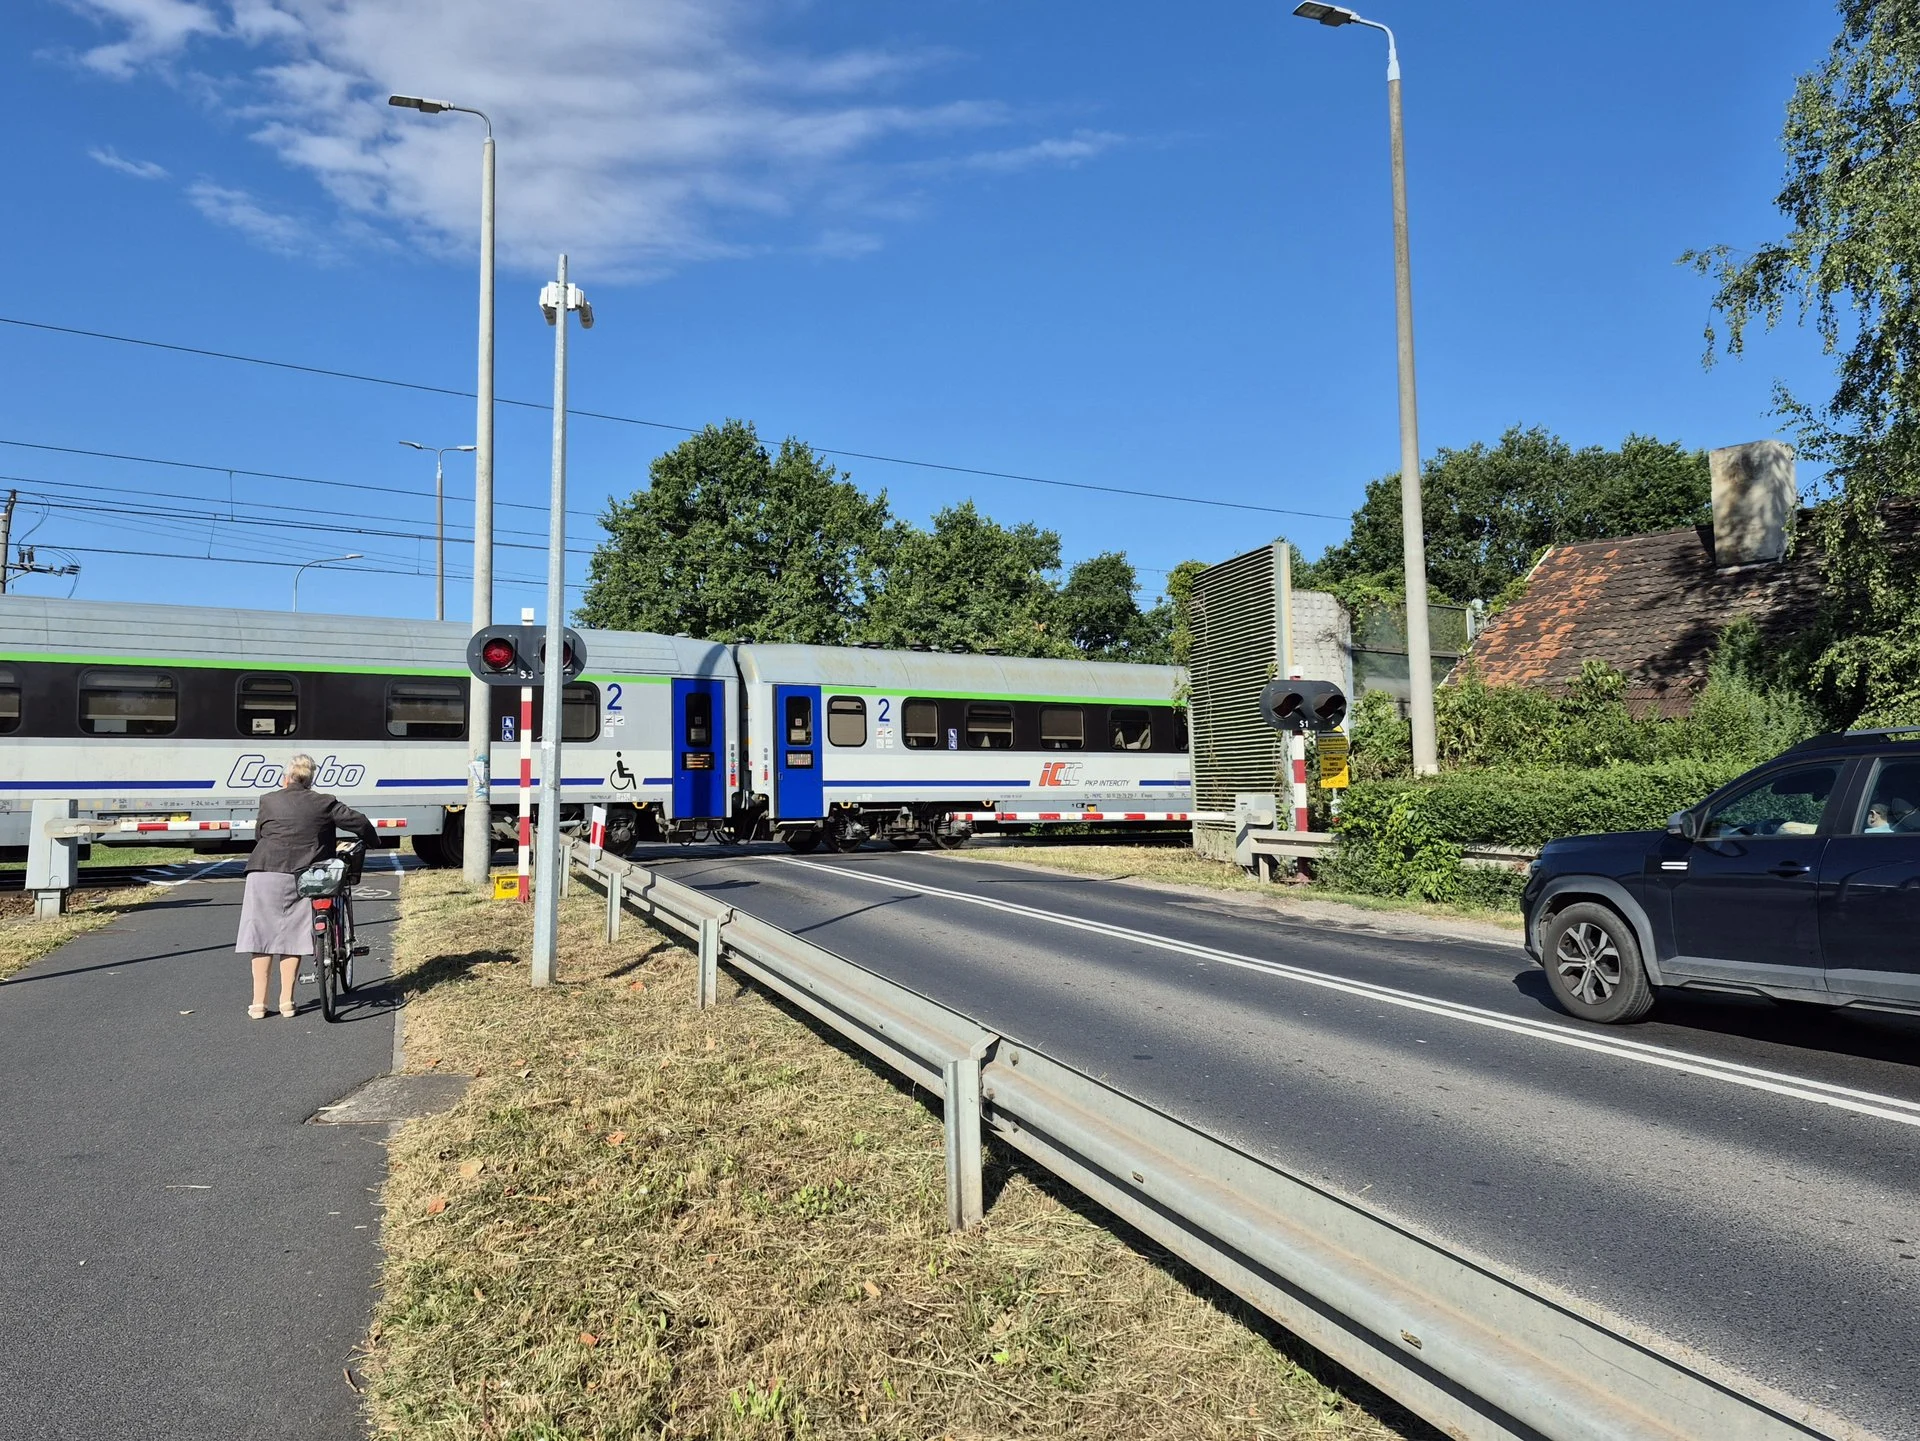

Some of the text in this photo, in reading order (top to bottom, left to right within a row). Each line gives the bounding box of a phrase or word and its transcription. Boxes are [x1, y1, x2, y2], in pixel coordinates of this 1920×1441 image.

[607, 683, 622, 710] 2
[878, 698, 890, 722] 2
[1299, 719, 1309, 728] S1
[226, 754, 365, 788] Cobo
[1085, 779, 1130, 787] PKP INTERCITY
